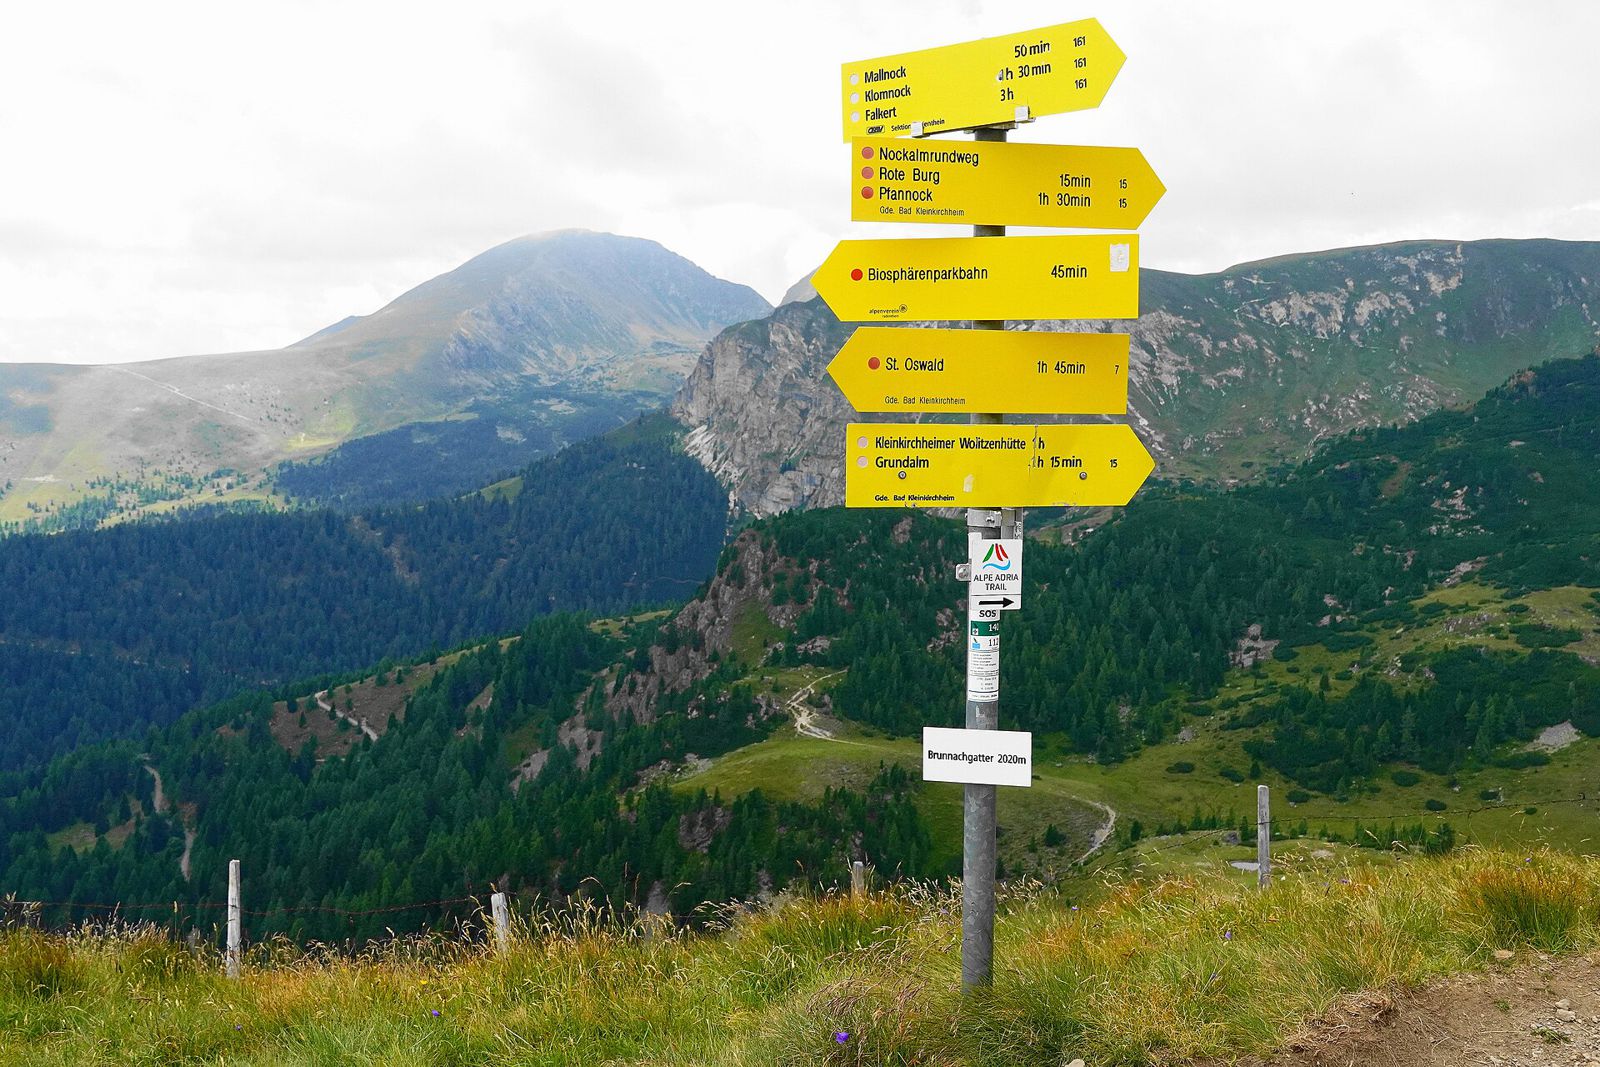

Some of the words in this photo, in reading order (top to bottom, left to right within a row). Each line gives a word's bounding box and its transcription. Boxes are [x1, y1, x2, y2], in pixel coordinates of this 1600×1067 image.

[1073, 36, 1086, 47] 161
[1014, 44, 1027, 58] 50
[1029, 40, 1050, 55] min
[1073, 57, 1087, 68] 161
[864, 66, 907, 83] Mallnock
[1006, 67, 1013, 80] h
[1018, 64, 1030, 78] 30
[1031, 63, 1052, 76] min
[1074, 78, 1088, 89] 161
[865, 84, 911, 102] Klomnock
[1000, 89, 1006, 101] 3
[1007, 87, 1014, 100] h
[865, 106, 897, 121] Falkert
[879, 147, 979, 167] Nockalmrundweg
[879, 166, 905, 181] Rote
[912, 167, 940, 185] Burg
[1059, 173, 1091, 188] 15min
[1119, 179, 1128, 189] 15
[879, 186, 933, 202] Pfannock
[1038, 192, 1049, 206] 1h
[1056, 192, 1091, 207] 30min
[1119, 198, 1128, 209] 15
[879, 205, 895, 215] Gde.
[898, 206, 912, 215] Bad
[915, 207, 965, 217] Kleinkirchheim
[868, 266, 989, 284] Biosphärenparkbahn
[1050, 264, 1088, 279] 45min
[885, 356, 899, 371] St.
[904, 357, 945, 372] Oswald
[1037, 360, 1048, 374] 1h
[1054, 361, 1086, 375] 45min
[1114, 364, 1120, 375] 7
[884, 395, 899, 405] Gde.
[903, 395, 916, 405] Bad
[919, 396, 966, 406] Kleinkirchheim
[875, 436, 956, 449] Kleinkirchheimer
[959, 437, 1026, 450] Wolitzenhütte
[1038, 436, 1046, 450] h
[875, 456, 930, 469] Grundalm
[1037, 455, 1045, 468] h
[1050, 456, 1061, 468] 15
[1061, 455, 1083, 468] min
[1110, 459, 1118, 468] 15
[875, 494, 890, 502] Gde.
[893, 494, 906, 502] Bad
[908, 494, 956, 502] Kleinkirchheim
[973, 573, 993, 582] ALPE
[995, 573, 1019, 582] ADRIA
[985, 583, 1007, 591] TRAIL
[979, 609, 997, 618] SOS
[928, 749, 995, 765] Brunnachgatter
[997, 753, 1027, 765] 2020m
